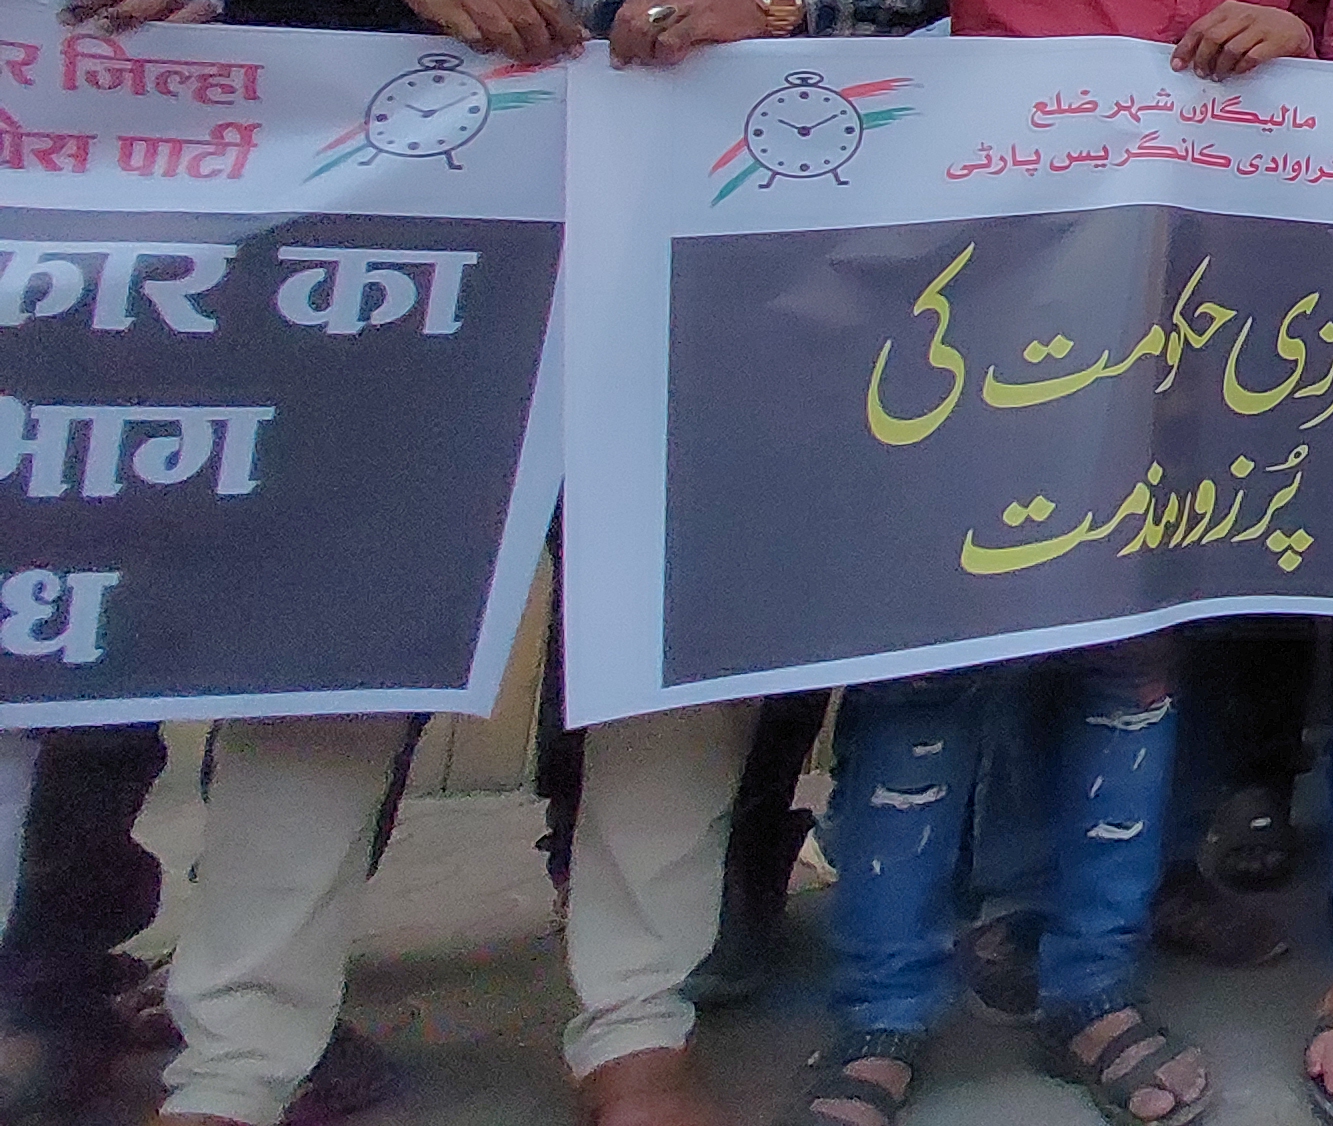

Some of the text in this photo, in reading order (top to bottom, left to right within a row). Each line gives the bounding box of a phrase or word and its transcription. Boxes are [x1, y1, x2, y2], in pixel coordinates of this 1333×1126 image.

[60, 33, 265, 105] जिल्हा
[1030, 89, 1099, 128] ضلع
[1110, 87, 1176, 123] شہر
[117, 122, 262, 179] पार्टी
[946, 142, 1041, 180] پارٹی
[276, 246, 481, 335] का
[866, 241, 975, 445] کی
[982, 255, 1238, 408] حکومت
